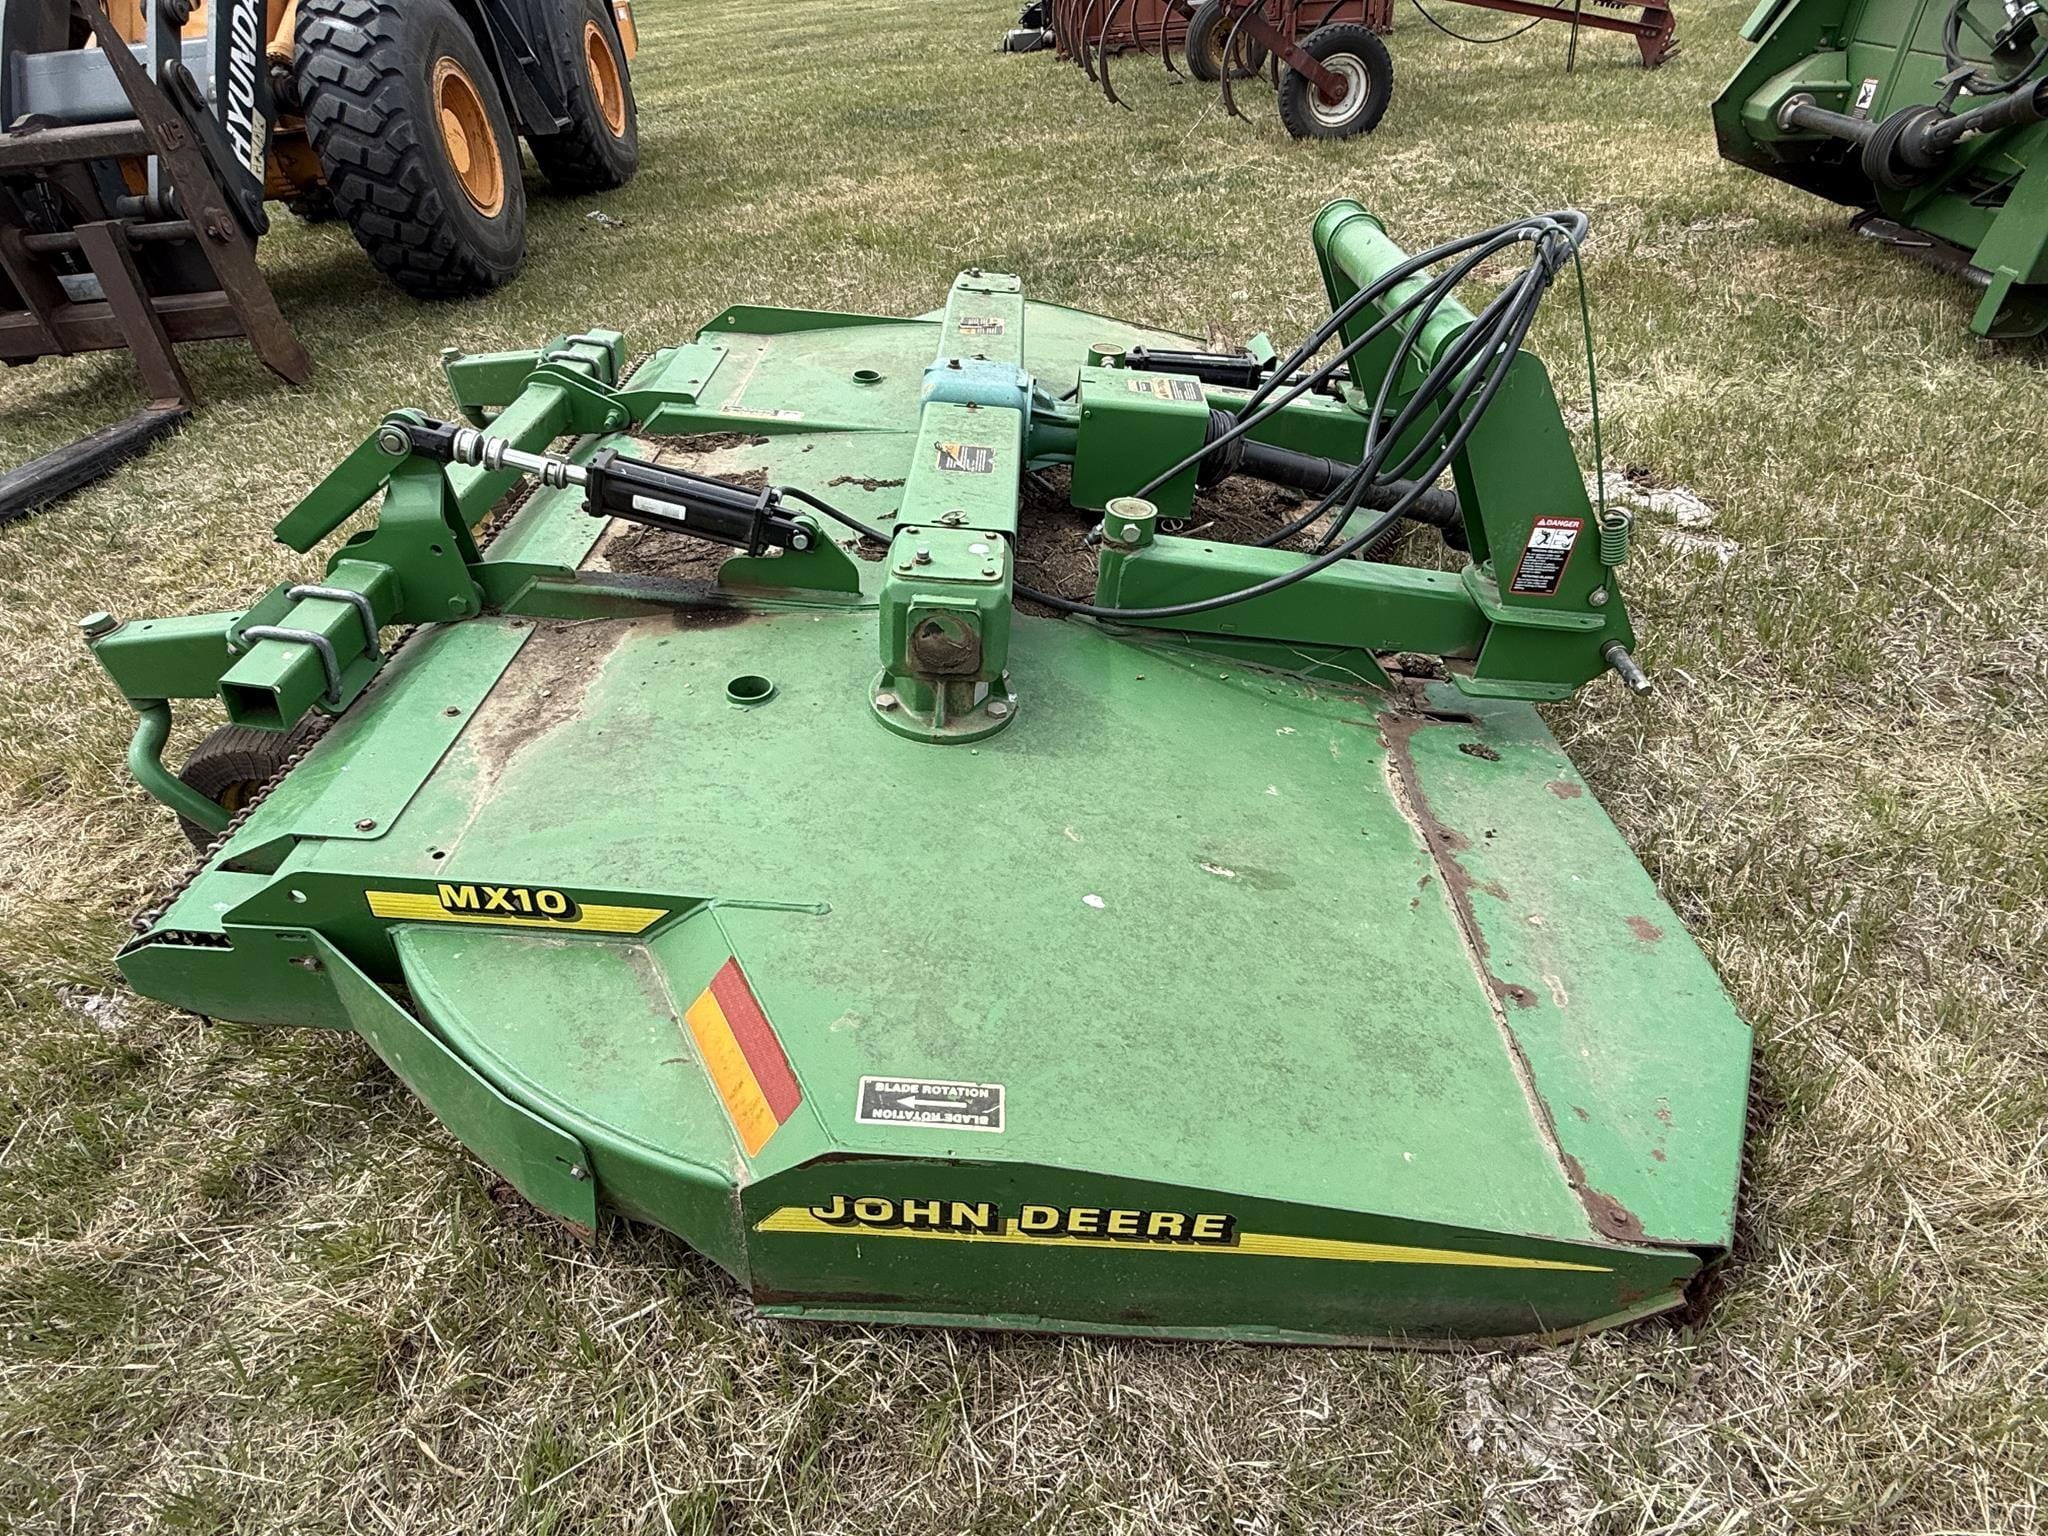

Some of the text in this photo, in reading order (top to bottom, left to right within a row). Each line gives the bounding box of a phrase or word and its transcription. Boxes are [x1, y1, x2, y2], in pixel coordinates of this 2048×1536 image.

[1546, 519, 1580, 528] DANGER
[437, 883, 569, 915] MX10
[874, 1082, 989, 1098] BLADE ROTATION
[872, 1108, 989, 1125] BLADE ROTATION
[812, 1195, 1229, 1239] JOHN DEERE
